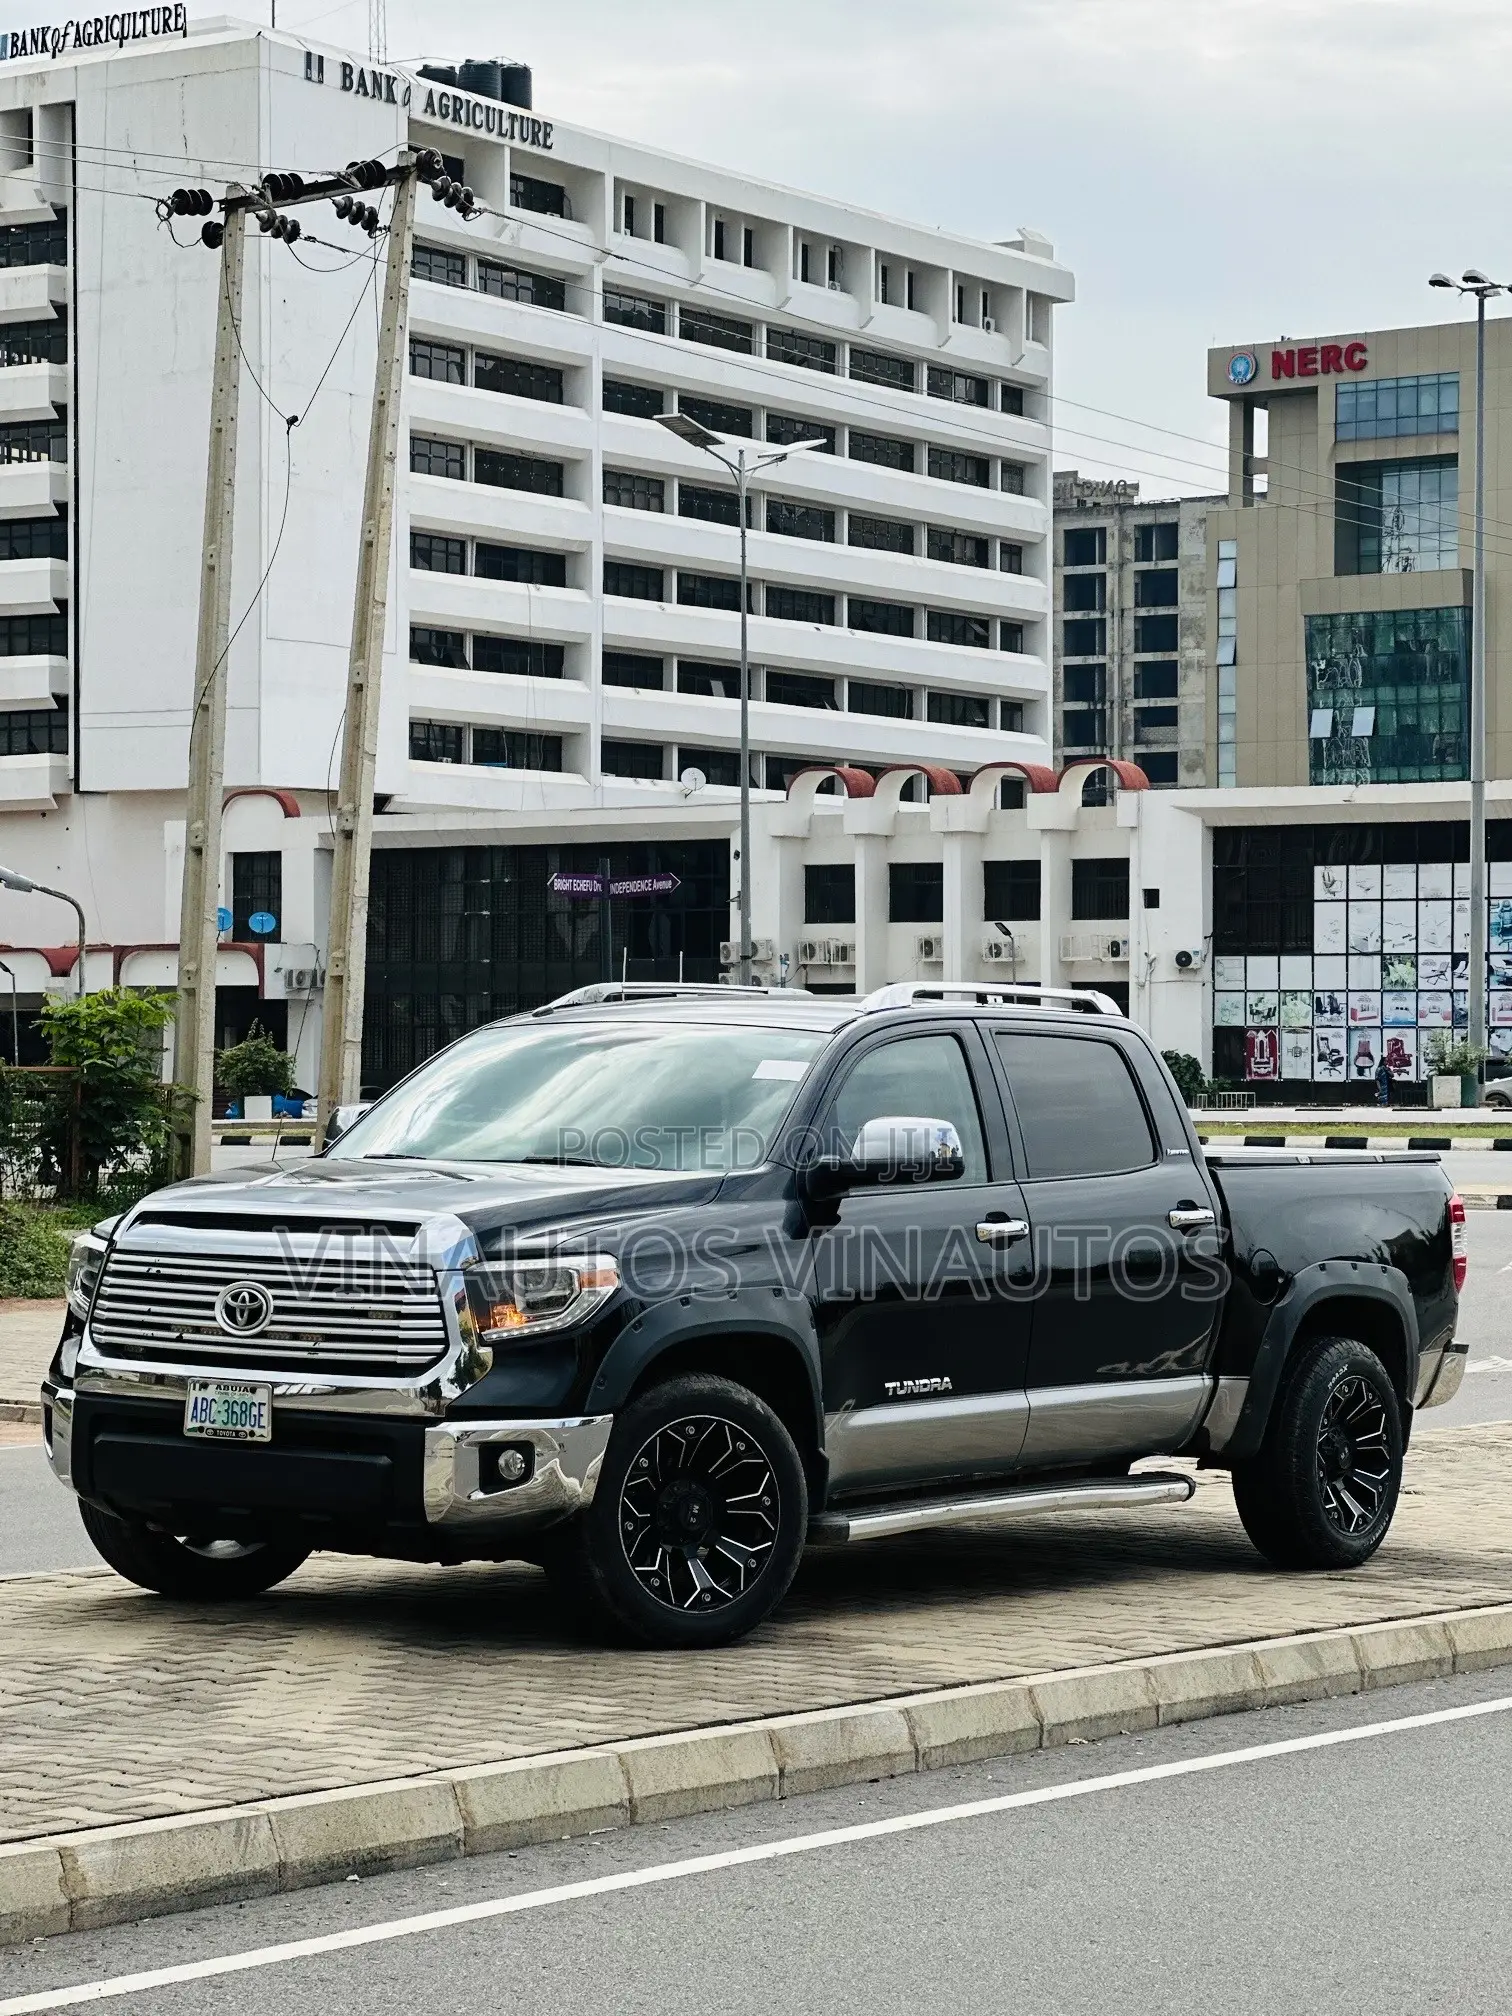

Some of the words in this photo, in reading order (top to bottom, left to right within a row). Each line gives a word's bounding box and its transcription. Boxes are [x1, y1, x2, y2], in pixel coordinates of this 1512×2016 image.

[10, 26, 51, 59] BANK
[74, 3, 184, 49] AGRICULTURE
[341, 61, 398, 105] BANK
[423, 87, 554, 150] AGRICULTURE
[1271, 342, 1369, 381] NERC
[554, 879, 573, 890] BRIGHT
[573, 879, 593, 891] ECHEFU
[610, 880, 652, 895] INDEPENDENCE
[652, 879, 672, 890] Avenue
[215, 1384, 249, 1394] ABUJA
[884, 1376, 953, 1396] TUNDRA
[190, 1396, 267, 1429] ABC-368GE
[216, 1429, 236, 1437] TOYOTA
